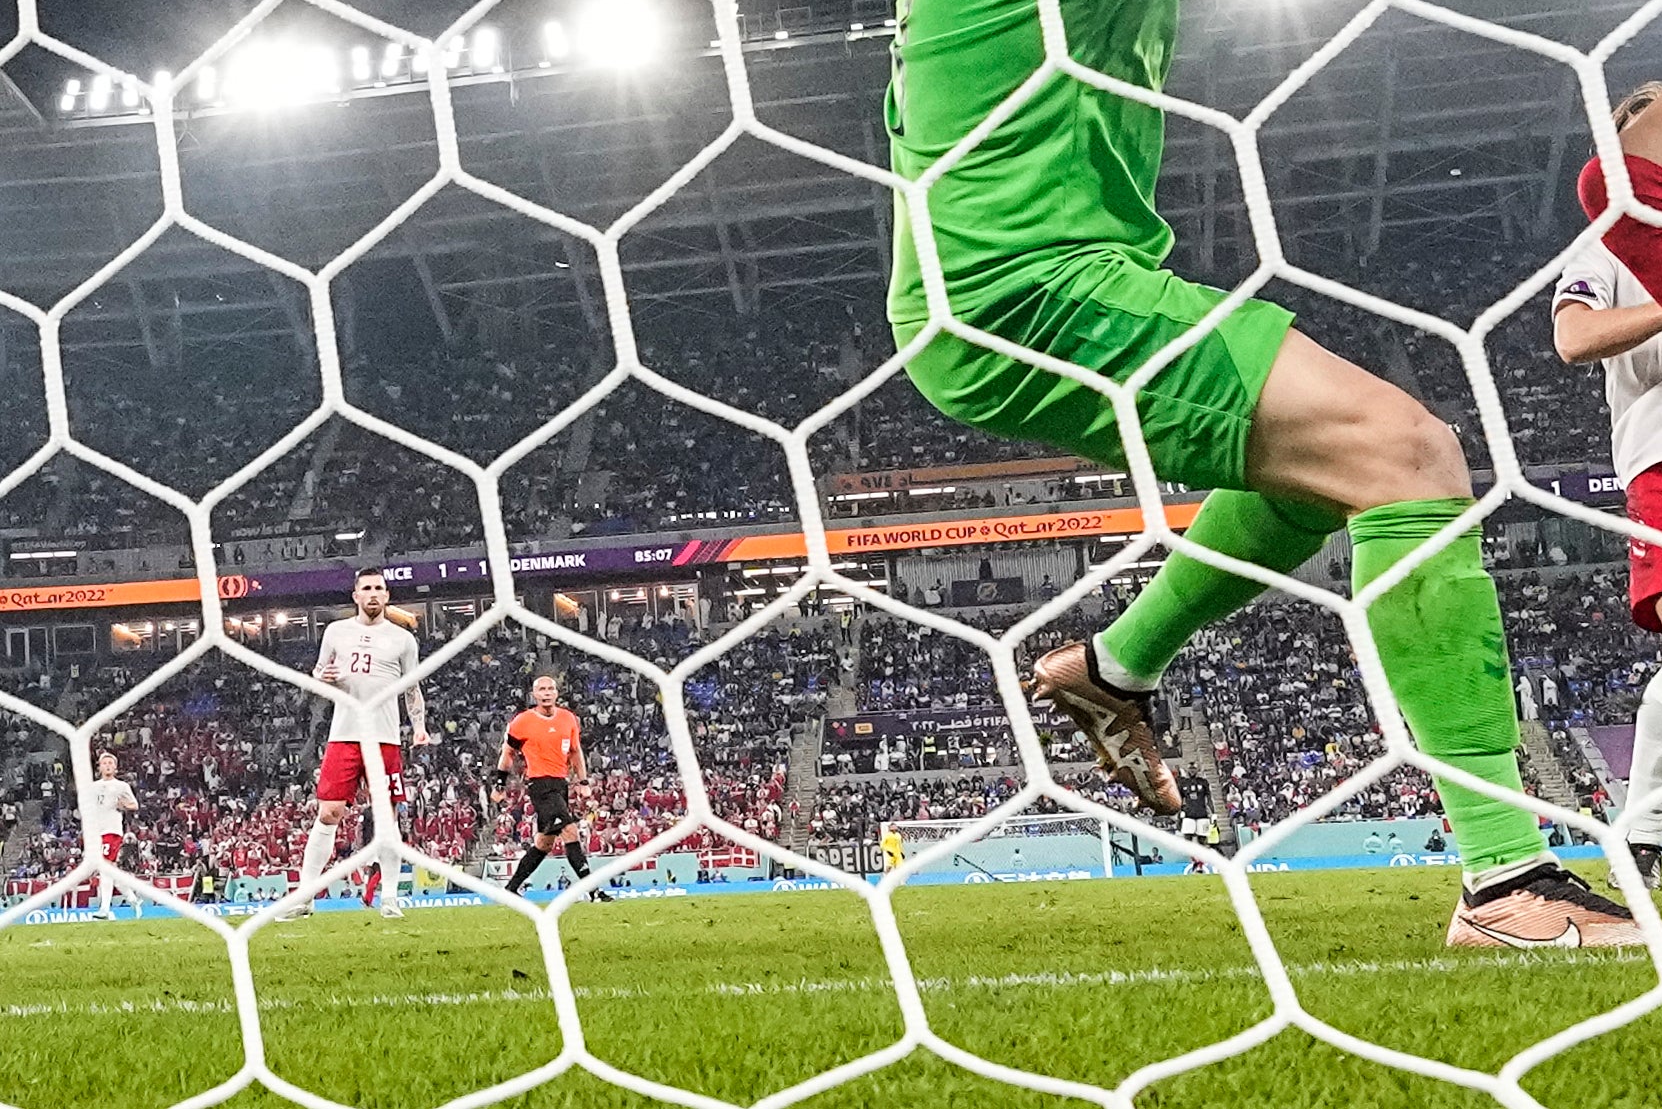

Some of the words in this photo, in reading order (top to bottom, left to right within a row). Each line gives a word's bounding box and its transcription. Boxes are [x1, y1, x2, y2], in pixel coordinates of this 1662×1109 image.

[846, 532, 881, 547] FIFA
[883, 528, 943, 545] WORLD
[945, 526, 977, 540] CUP
[993, 516, 1102, 538] Qatar2022
[438, 564, 447, 578] 1
[511, 554, 586, 573] DENMARK
[635, 549, 673, 563] 85:07
[11, 589, 106, 608] Qatar2022
[350, 652, 372, 674] 23
[983, 716, 1010, 728] FIFA
[384, 772, 404, 796] 3
[414, 896, 483, 909] WANDA
